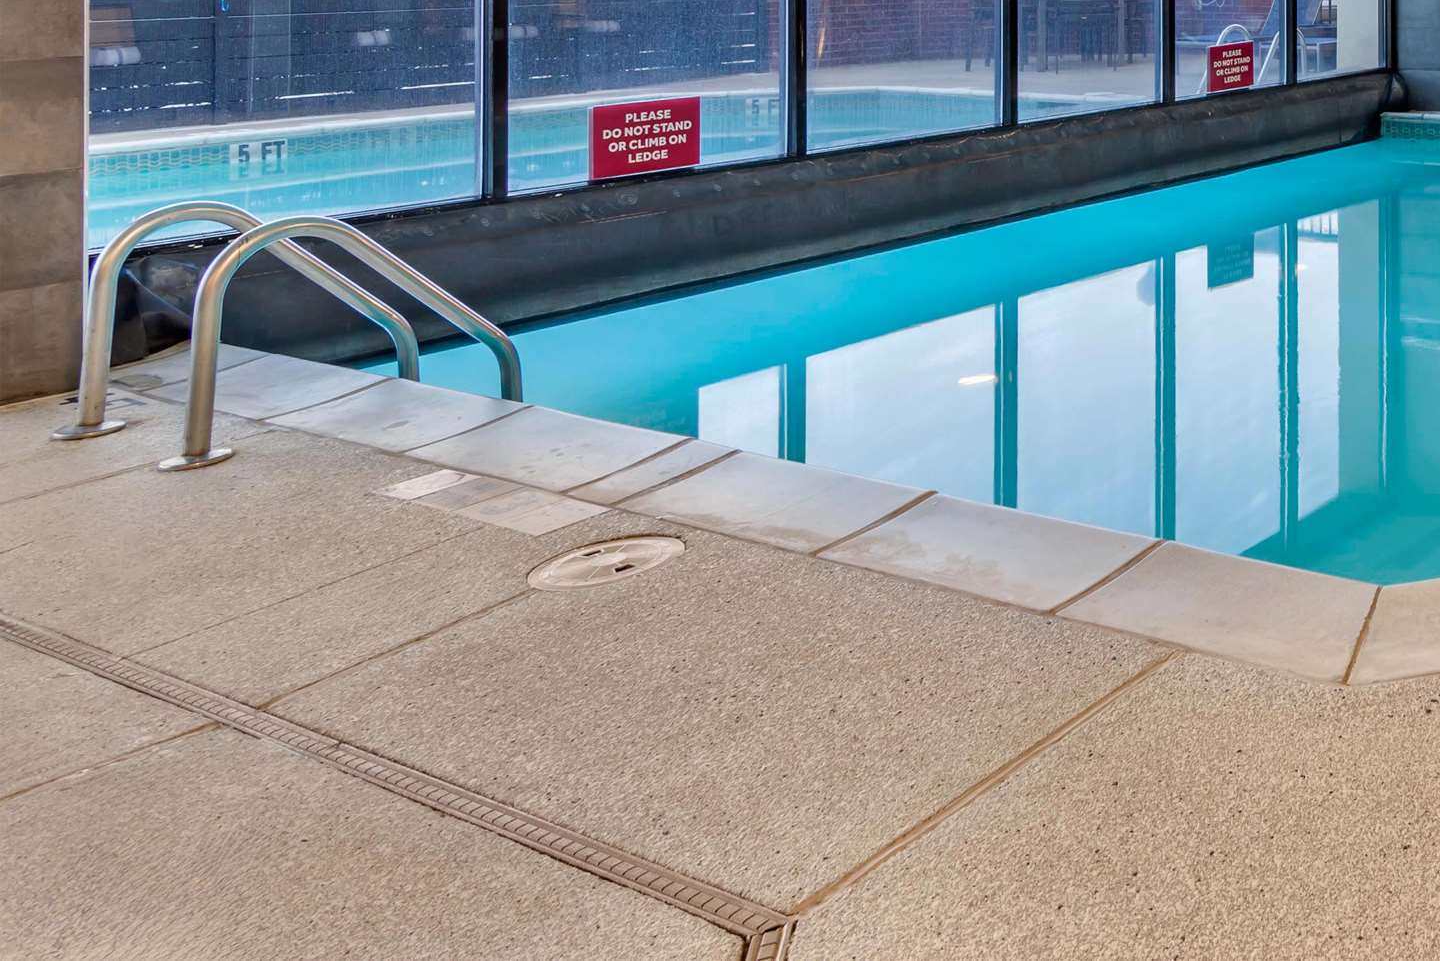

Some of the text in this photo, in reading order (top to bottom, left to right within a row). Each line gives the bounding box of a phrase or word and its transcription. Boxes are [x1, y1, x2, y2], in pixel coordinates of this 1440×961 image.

[1222, 49, 1242, 59] PLEASE
[1213, 56, 1251, 69] DO NOT STAND
[1215, 65, 1249, 76] OR CLIMB ON
[1223, 75, 1242, 84] LEDGE
[625, 109, 672, 124] PLEASE
[602, 120, 692, 140] DO NOT STAND
[608, 134, 688, 153] OR CLIMB ON
[238, 140, 285, 163] 5 FT
[628, 149, 669, 164] LEDGE
